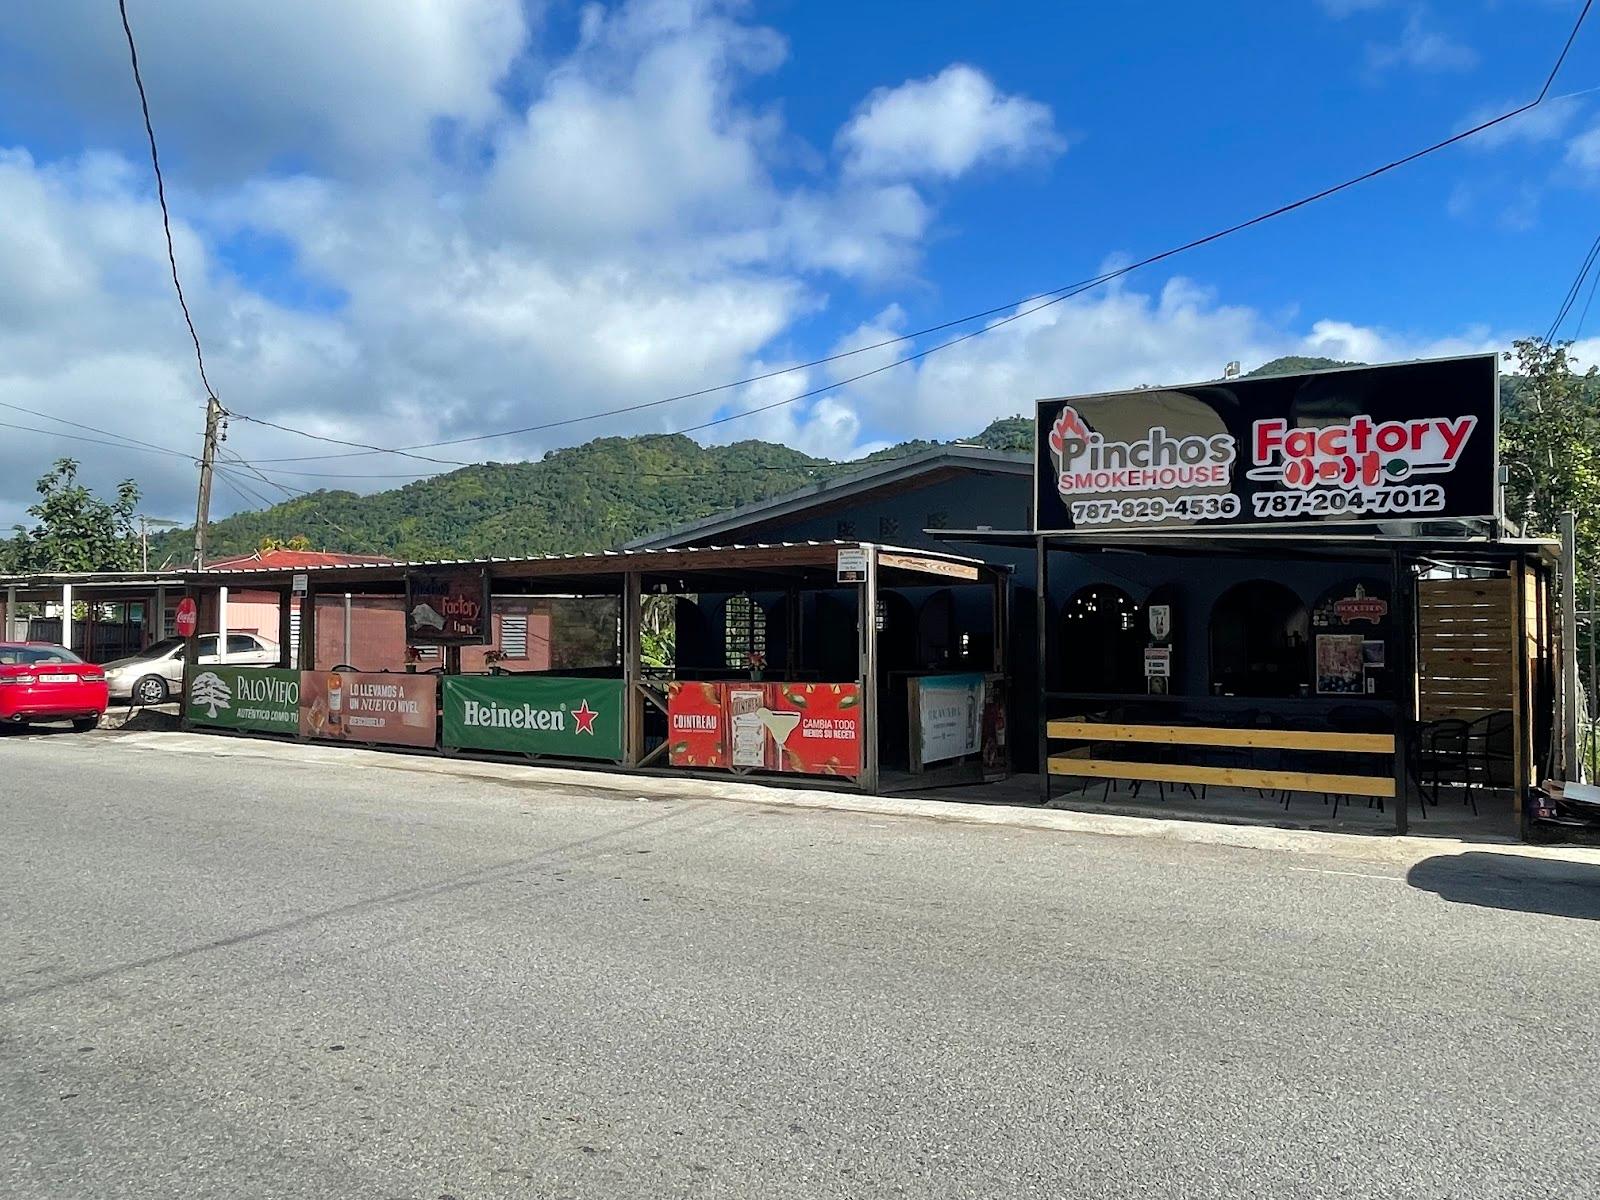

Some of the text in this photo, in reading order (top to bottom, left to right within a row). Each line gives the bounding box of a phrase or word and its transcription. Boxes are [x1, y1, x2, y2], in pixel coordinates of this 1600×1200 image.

[1062, 416, 1473, 472] Pinchos Factory
[1060, 466, 1225, 490] SMOKEHOUSE
[1073, 489, 1440, 520] 787-829-4536 787-204-7012
[350, 683, 405, 698] LO LLEVAMOS A
[360, 698, 397, 712] NUEVO
[397, 701, 419, 713] NIVEL
[464, 701, 565, 731] Heineken
[673, 714, 717, 730] COINTREAU
[803, 718, 855, 731] CAMBIA TODO
